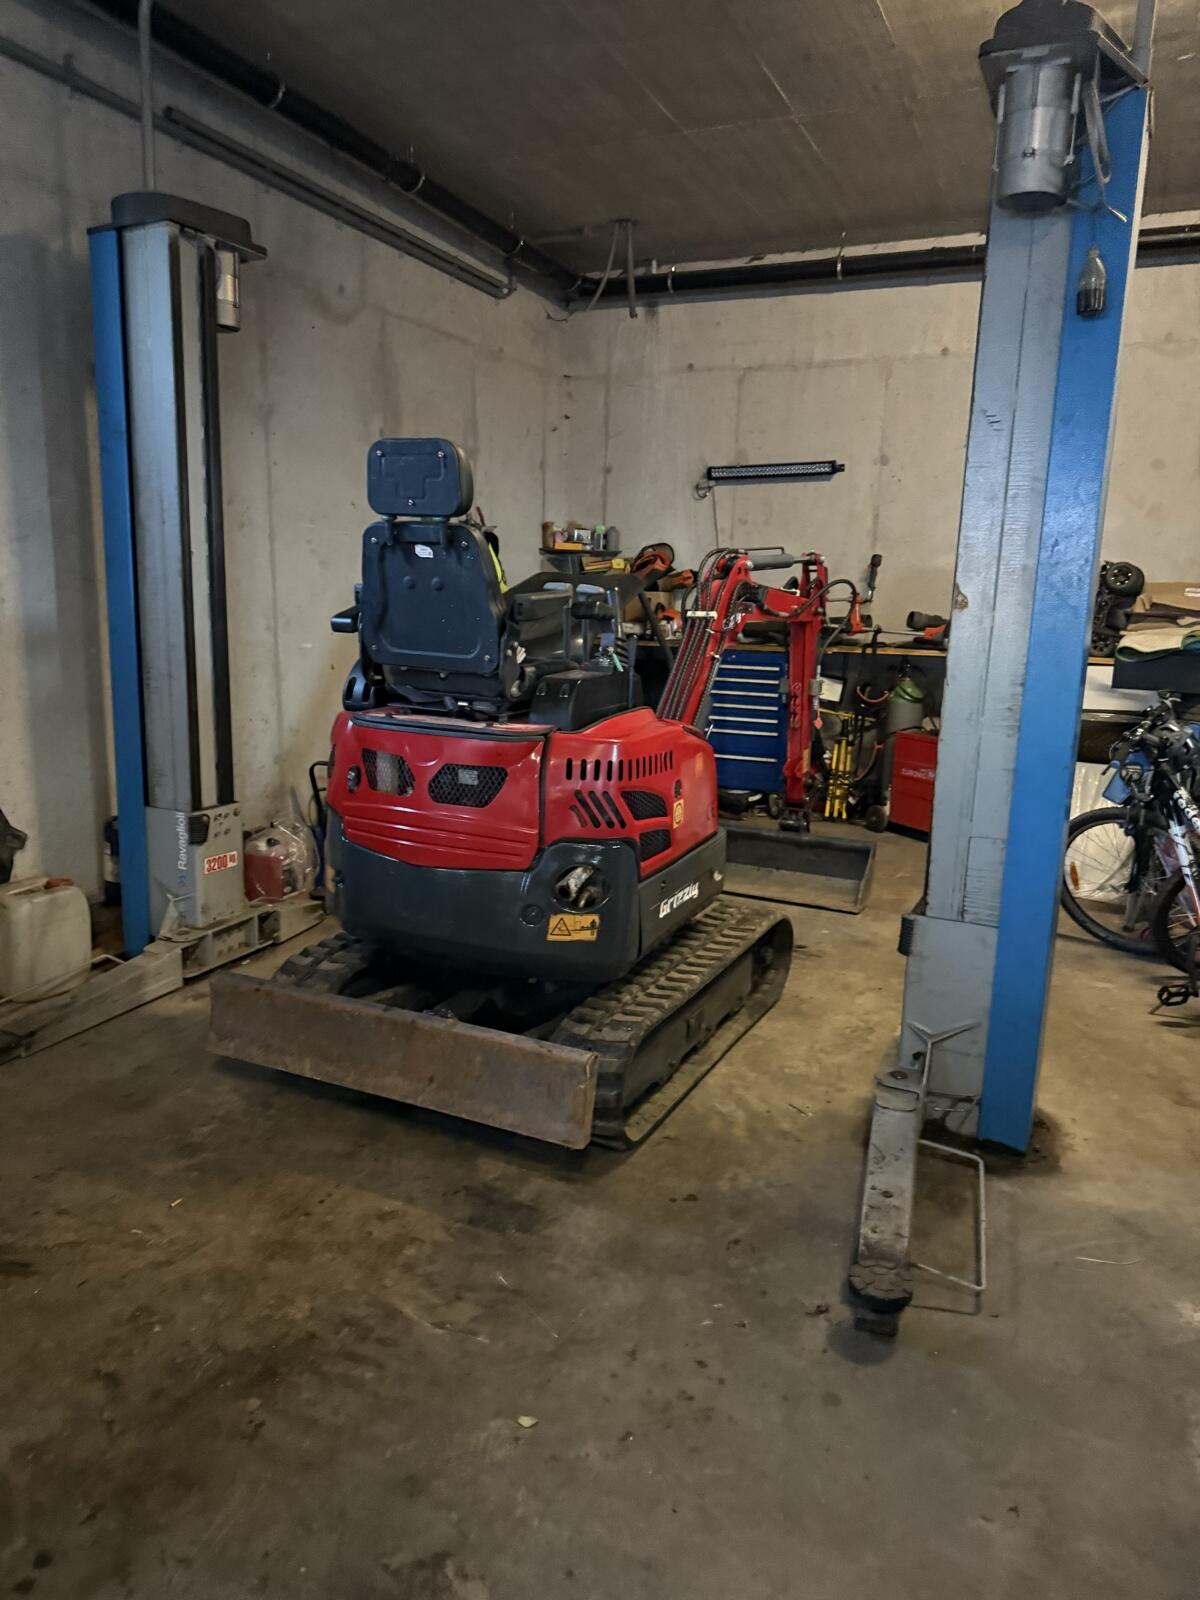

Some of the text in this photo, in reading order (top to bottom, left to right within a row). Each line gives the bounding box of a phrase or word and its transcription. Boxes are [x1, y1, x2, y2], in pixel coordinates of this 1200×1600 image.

[175, 811, 189, 870] Ravaglioli
[206, 854, 228, 873] 3200
[659, 881, 700, 919] Grizzly
